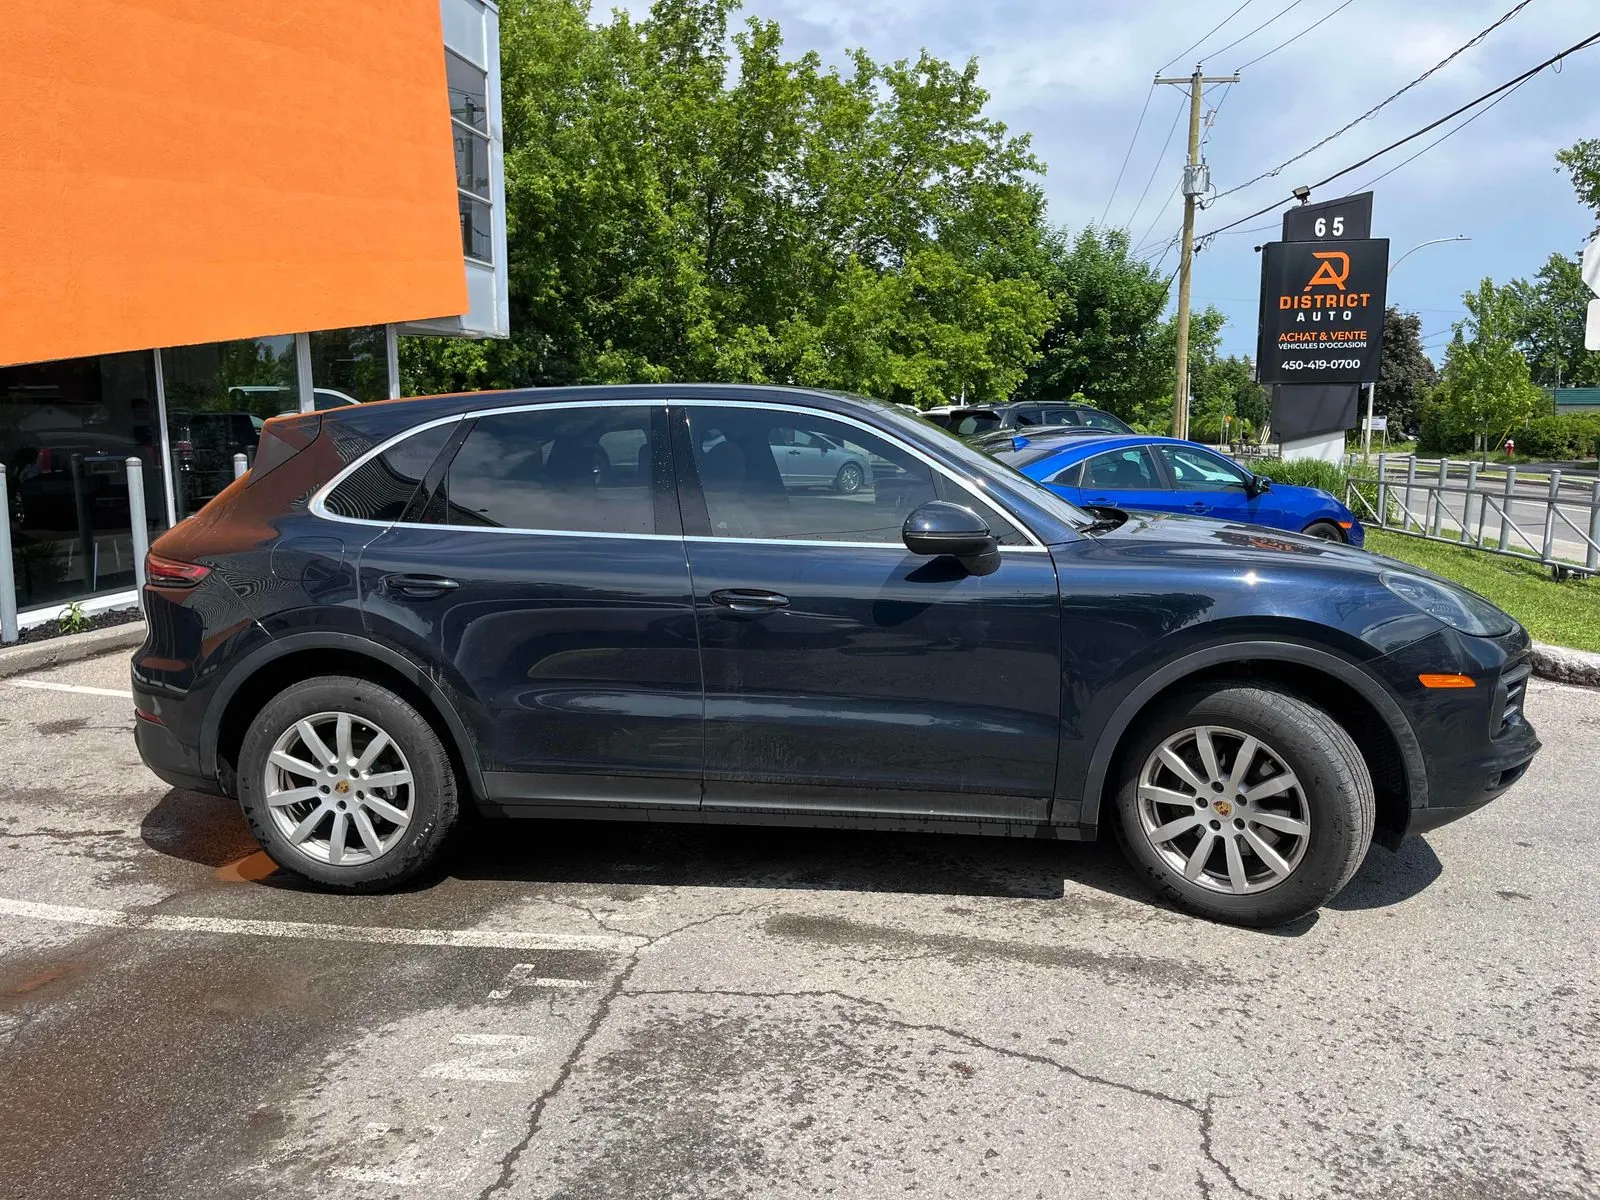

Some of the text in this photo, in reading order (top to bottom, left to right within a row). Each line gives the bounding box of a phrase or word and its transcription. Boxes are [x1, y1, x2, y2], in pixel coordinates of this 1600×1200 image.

[1314, 217, 1345, 237] 65
[1279, 293, 1371, 310] DISTRICT
[1296, 310, 1352, 322] AUTO
[1278, 330, 1368, 342] ACHAT & VENTE
[1319, 341, 1368, 349] D'OCCASION
[1281, 359, 1361, 370] 450-419-0700
